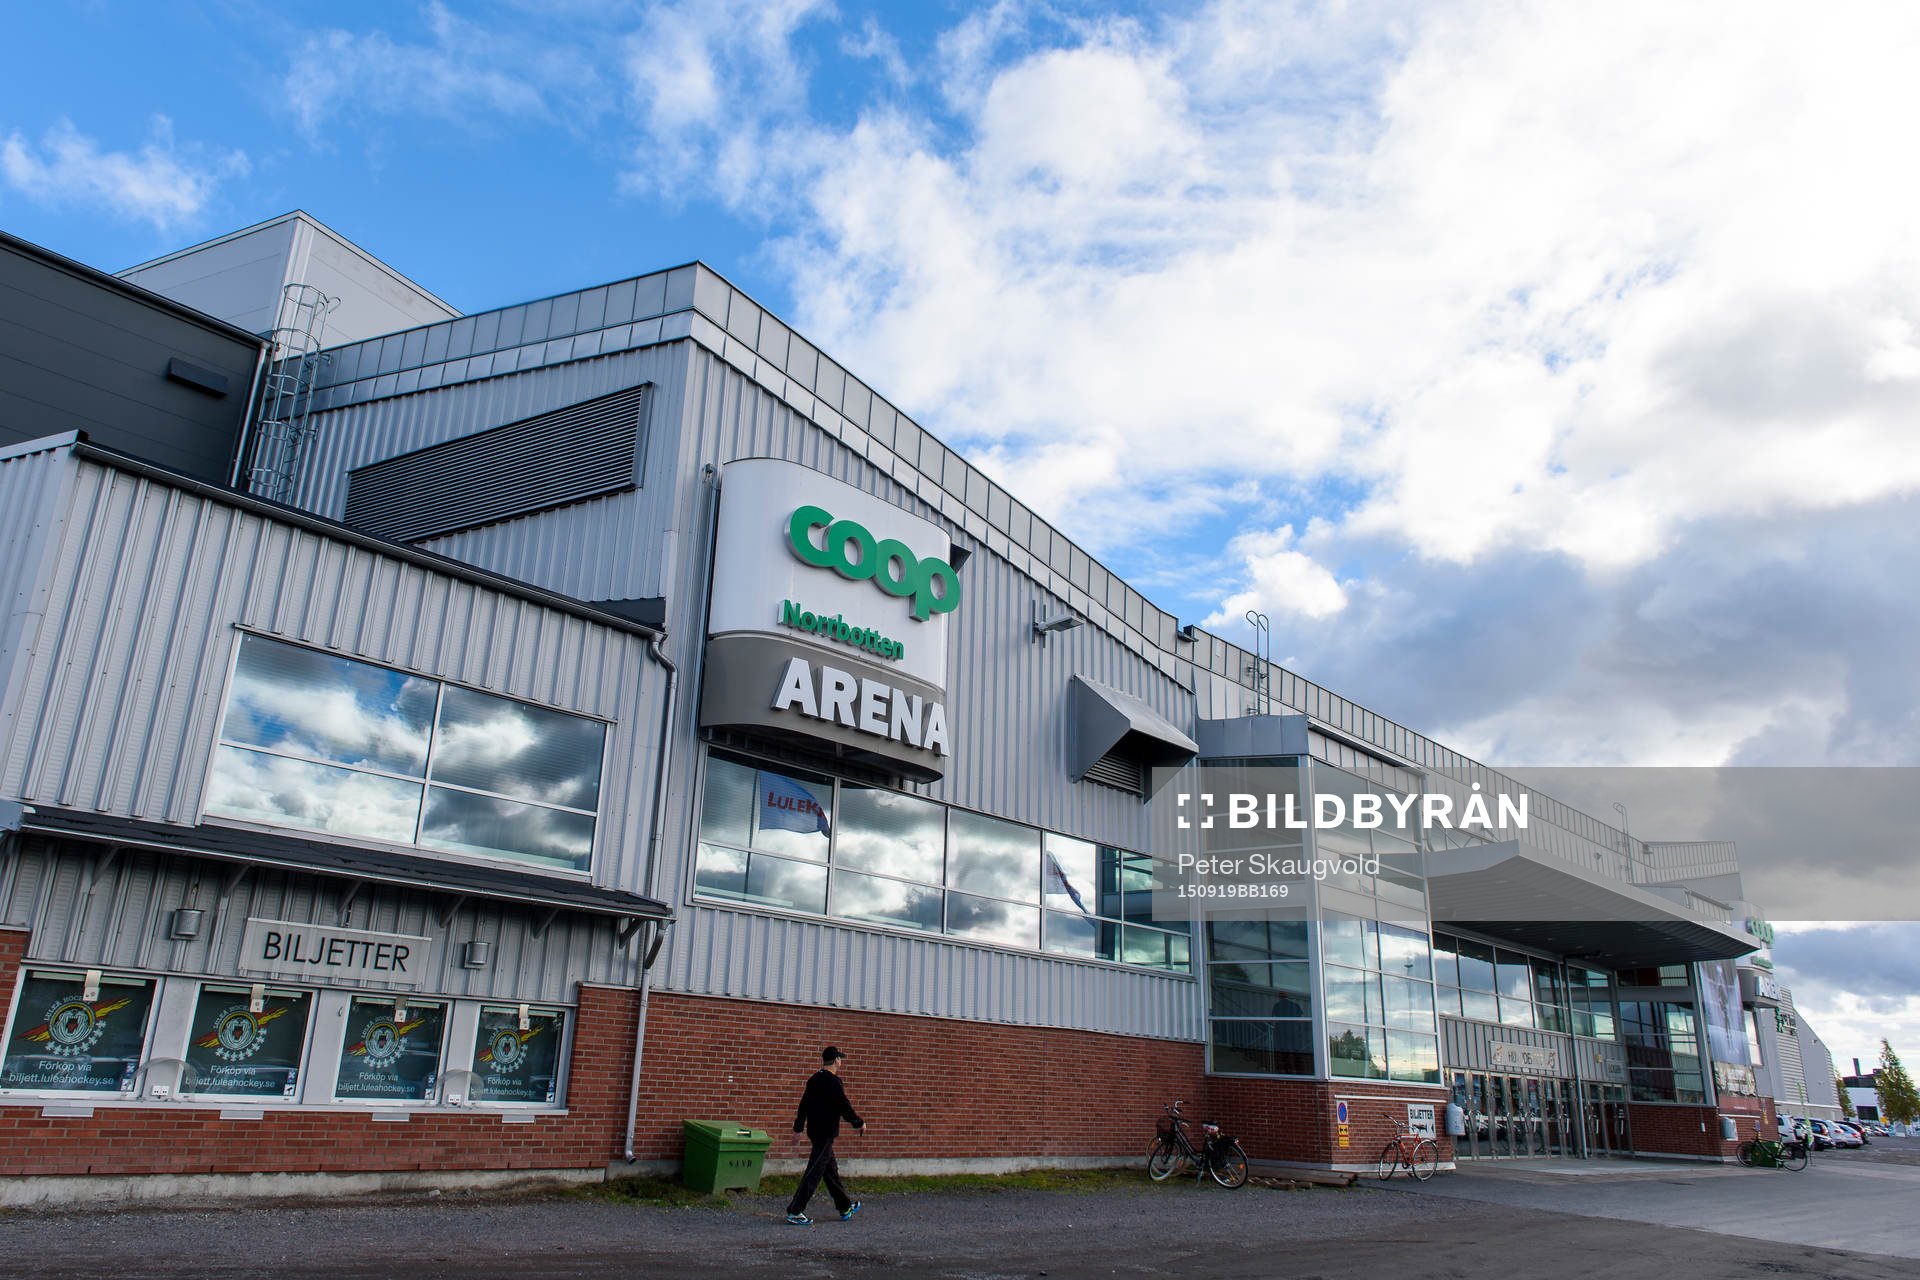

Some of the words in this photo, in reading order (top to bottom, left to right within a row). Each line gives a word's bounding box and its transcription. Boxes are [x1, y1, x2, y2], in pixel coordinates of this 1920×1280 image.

[785, 505, 961, 622] coop
[778, 599, 904, 660] Norrbotten
[771, 657, 950, 757] ARENA
[263, 931, 410, 972] BILJETTER
[77, 1062, 92, 1072] via
